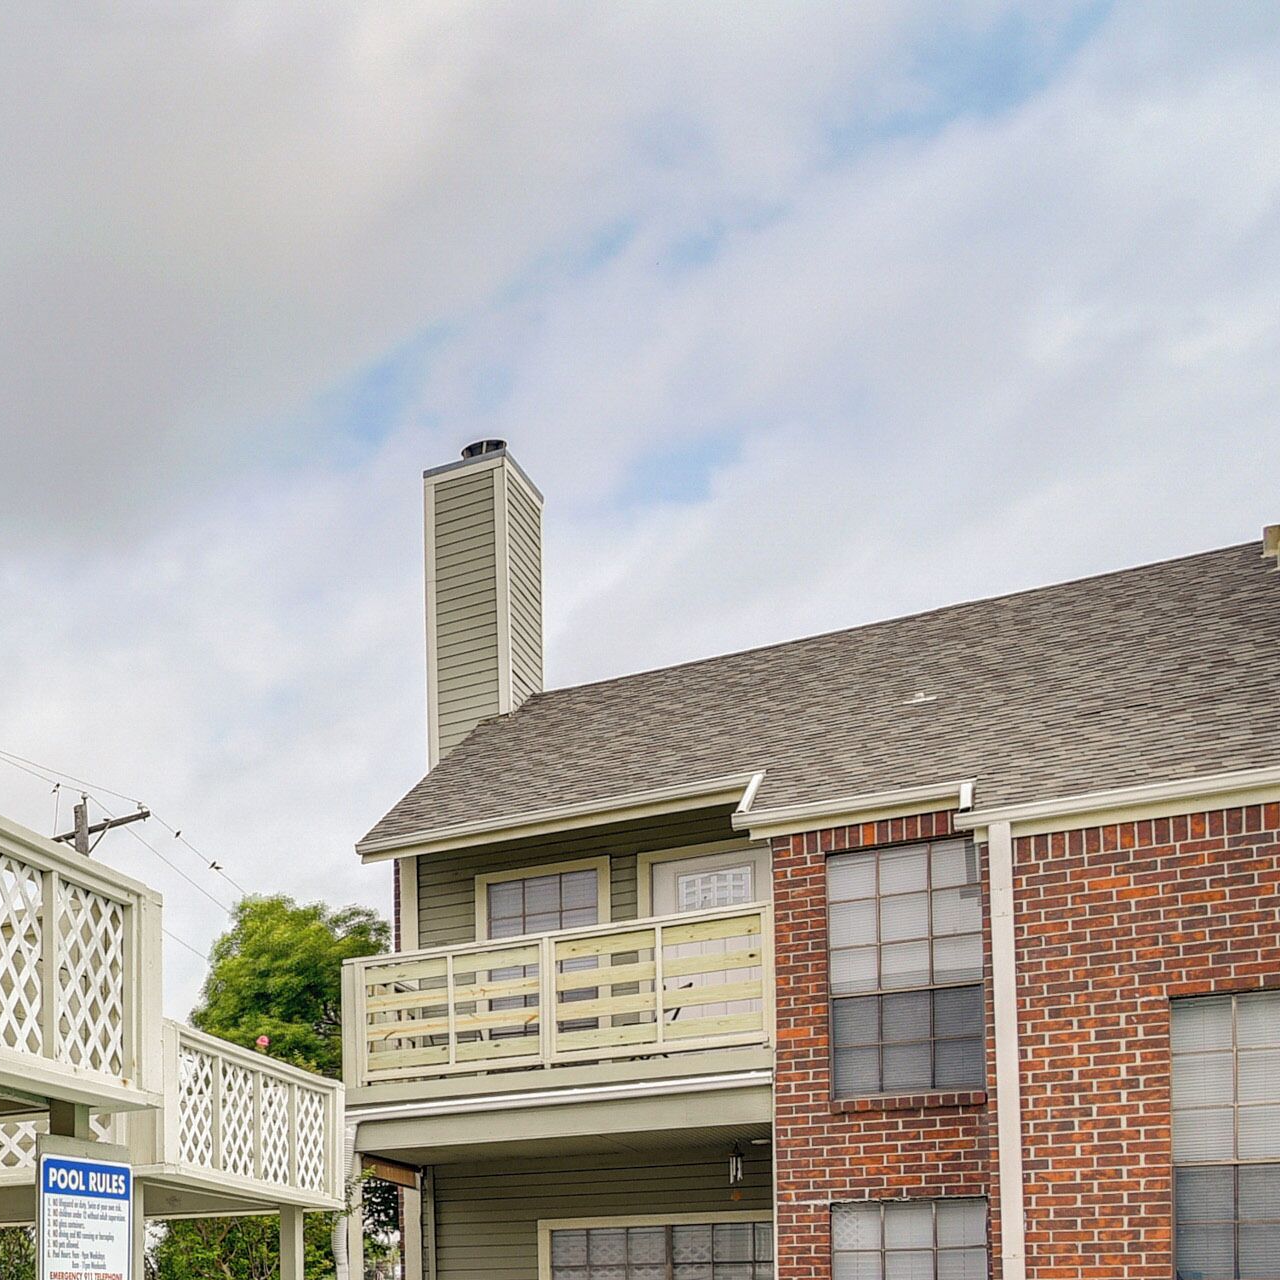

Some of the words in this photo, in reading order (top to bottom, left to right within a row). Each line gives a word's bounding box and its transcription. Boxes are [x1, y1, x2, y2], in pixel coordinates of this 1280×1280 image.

[48, 1167, 85, 1191] POOL
[88, 1171, 125, 1195] RULES
[49, 1271, 82, 1280] EMERGENCY
